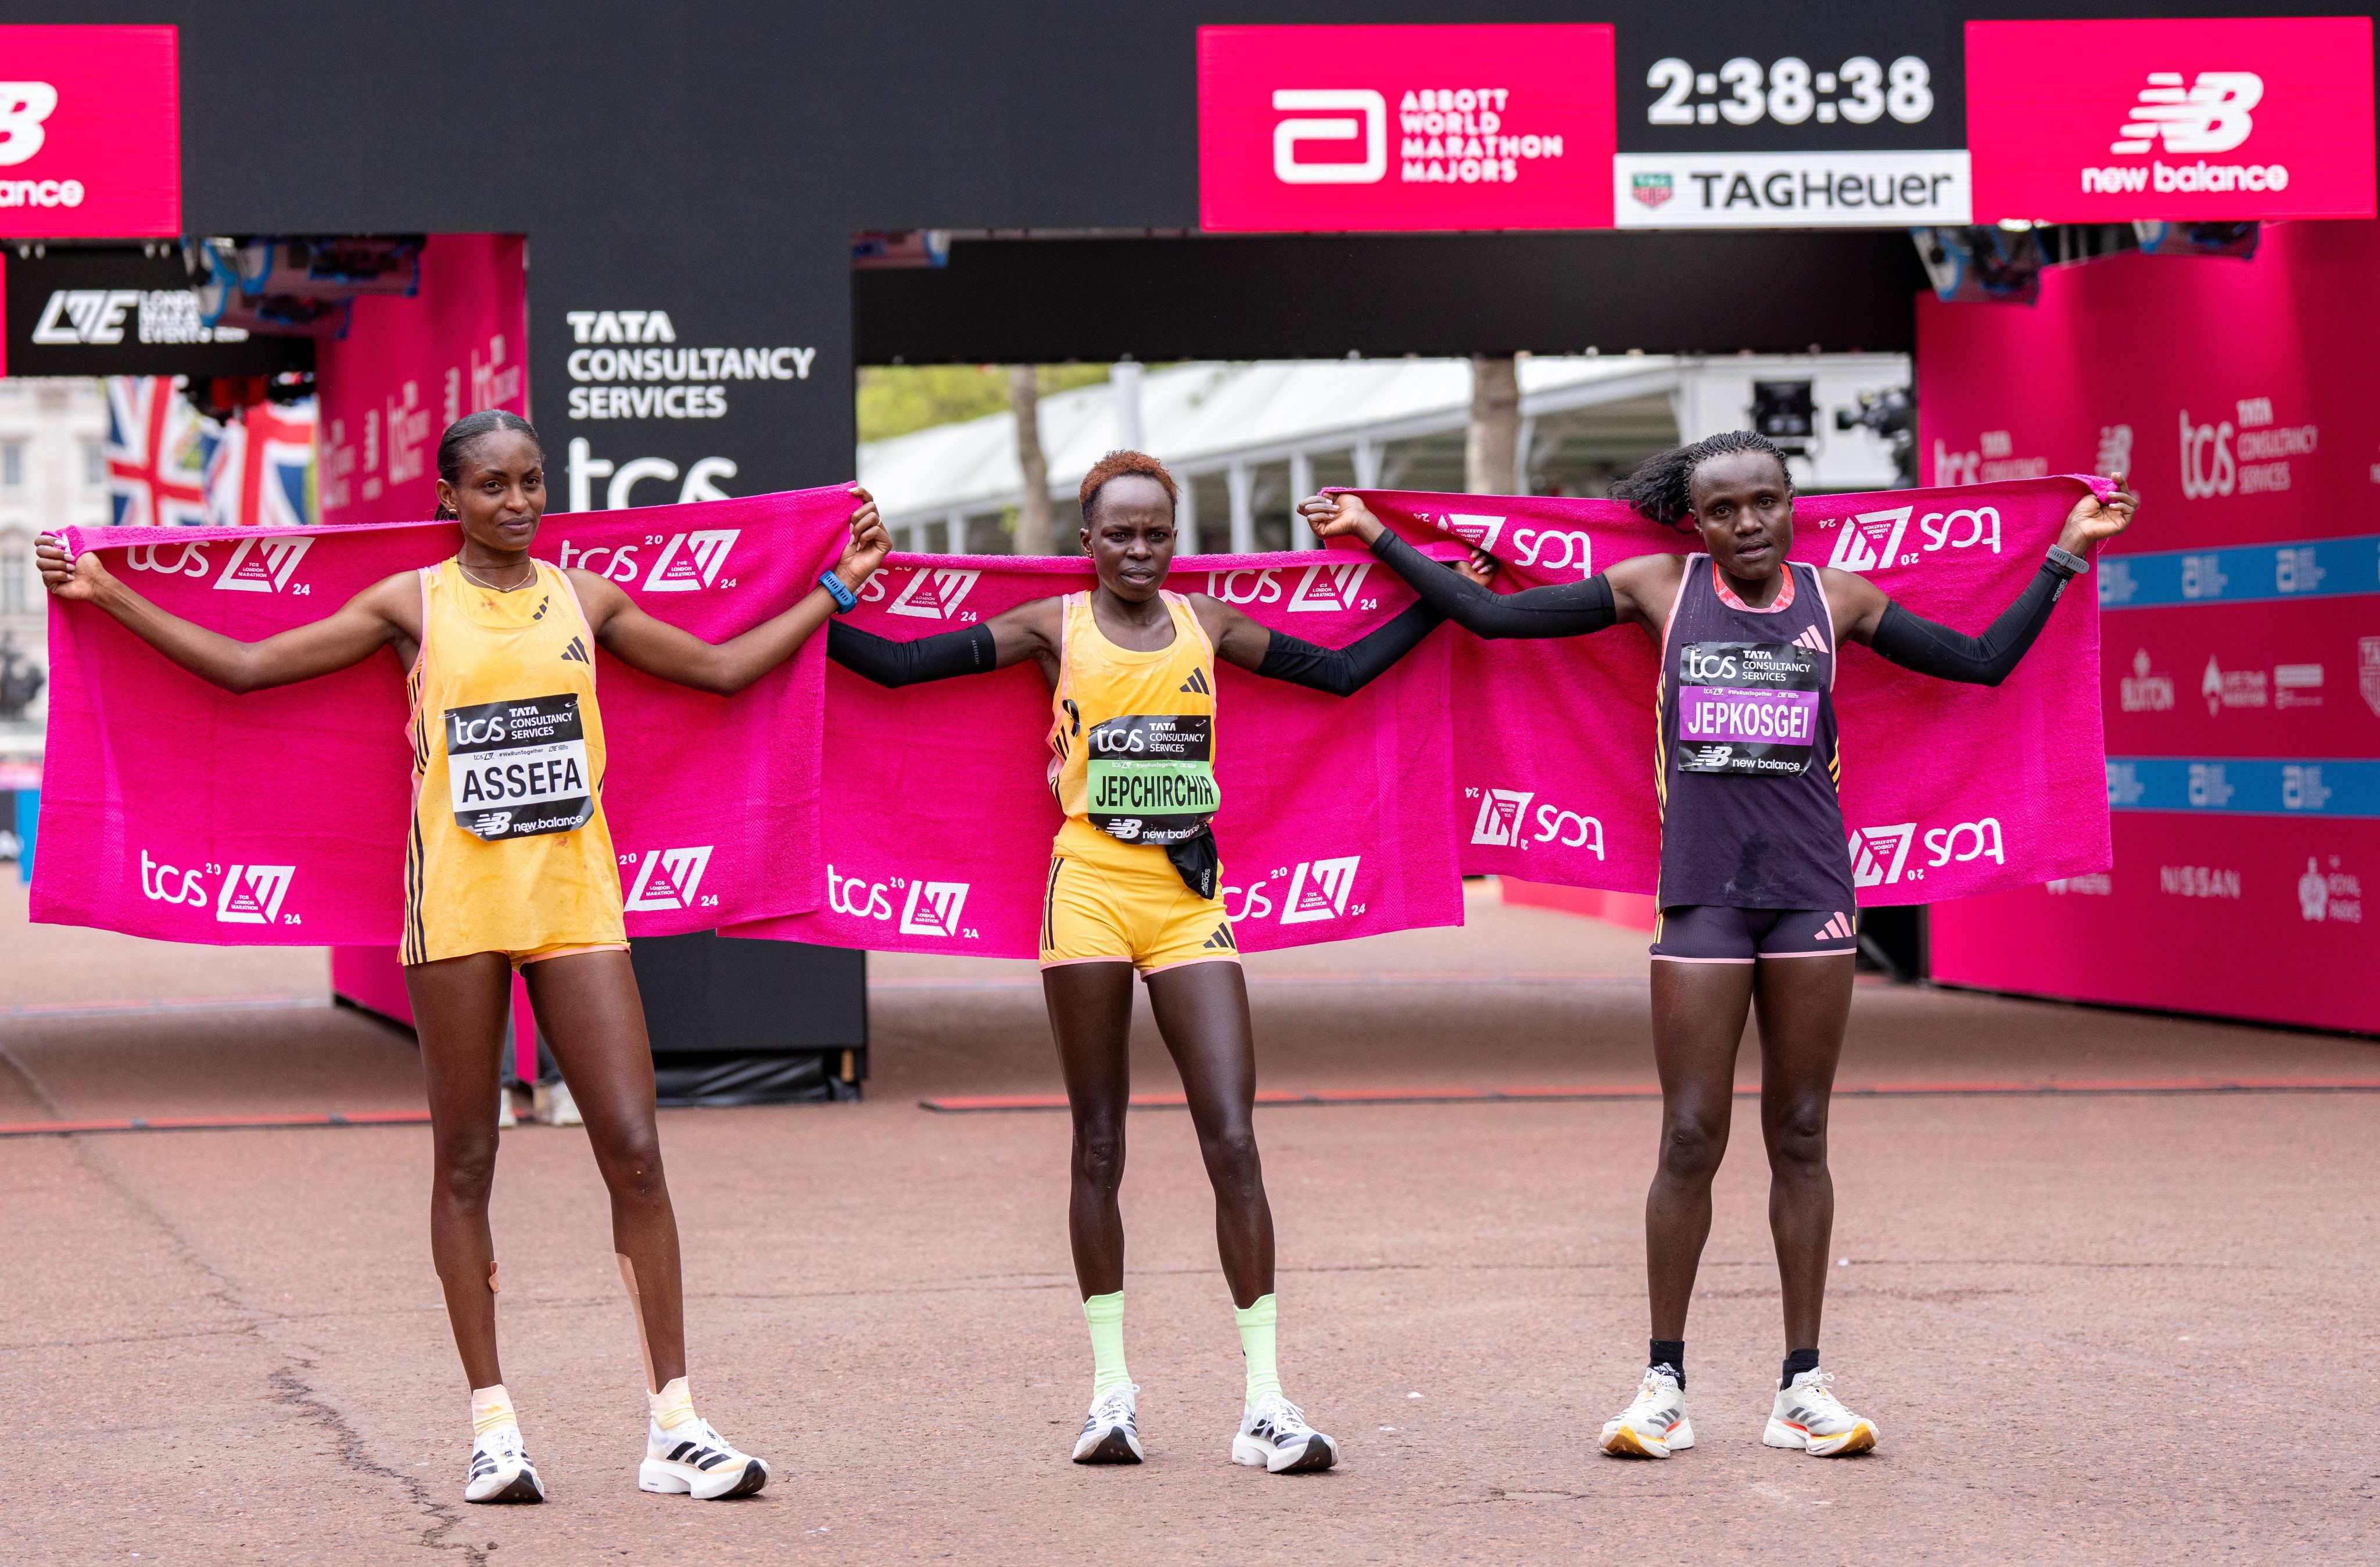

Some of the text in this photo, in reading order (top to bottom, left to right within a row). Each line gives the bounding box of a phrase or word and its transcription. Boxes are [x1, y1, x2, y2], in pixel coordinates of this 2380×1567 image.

[1400, 88, 1510, 112] ABBOTT
[1647, 55, 1934, 125] 2:38:38
[1399, 112, 1500, 135] WORLD
[1400, 134, 1563, 159] MARATHON
[1401, 159, 1517, 183] MAJORS
[2081, 160, 2288, 193] new balance
[0, 180, 85, 207] ance
[567, 310, 676, 343] TATA
[567, 347, 816, 382] CONSULTANCY
[568, 385, 727, 420] SERVICES
[2179, 408, 2236, 500] tcs
[1819, 519, 1836, 529] 24
[1920, 507, 2001, 554] tcs
[645, 535, 664, 545] 20
[721, 578, 737, 590] 24
[1513, 528, 1592, 579] tcs
[1901, 553, 1919, 566] 20
[292, 583, 311, 596] 24
[960, 611, 977, 622] 24
[1361, 598, 1377, 611] 24
[1690, 650, 1736, 679] tcs
[1743, 650, 1772, 659] TATA
[1743, 661, 1811, 672] CONSULTANCY
[1743, 672, 1786, 681] SERVICES
[509, 706, 539, 717] TATA
[510, 712, 572, 729] CONSULTANCY
[1688, 702, 1809, 738] JEPKOSGEI
[454, 715, 506, 745] tcs
[511, 726, 554, 740] SERVICES
[1149, 723, 1176, 731] TATA
[1149, 733, 1205, 743] CONSULTANCY
[1098, 728, 1144, 752] tcs
[1150, 744, 1184, 752] SERVICES
[499, 748, 543, 757] #WeRunTogether
[1733, 758, 1756, 768] new
[1758, 758, 1800, 770] balance
[462, 758, 582, 803] ASSEFA
[1096, 775, 1214, 807] JEPCHIRCHIR
[1465, 787, 1479, 798] 24
[514, 821, 537, 832] new
[539, 815, 583, 829] balance
[1143, 830, 1165, 838] new
[1168, 824, 1200, 838] balance
[1534, 804, 1604, 861] tcs
[1924, 817, 2004, 867] tcs
[141, 849, 206, 906] tcs
[206, 863, 221, 875] 20
[284, 913, 302, 925] 24
[619, 853, 637, 865] 20
[701, 895, 719, 907] 24
[1908, 869, 1924, 881] 20
[2160, 865, 2241, 899] NISSAN
[827, 864, 892, 920] tcs
[890, 876, 905, 889] 20
[963, 928, 979, 938] 24
[1221, 881, 1272, 922] cs
[1271, 866, 1288, 879] 20
[1351, 903, 1365, 916] 24
